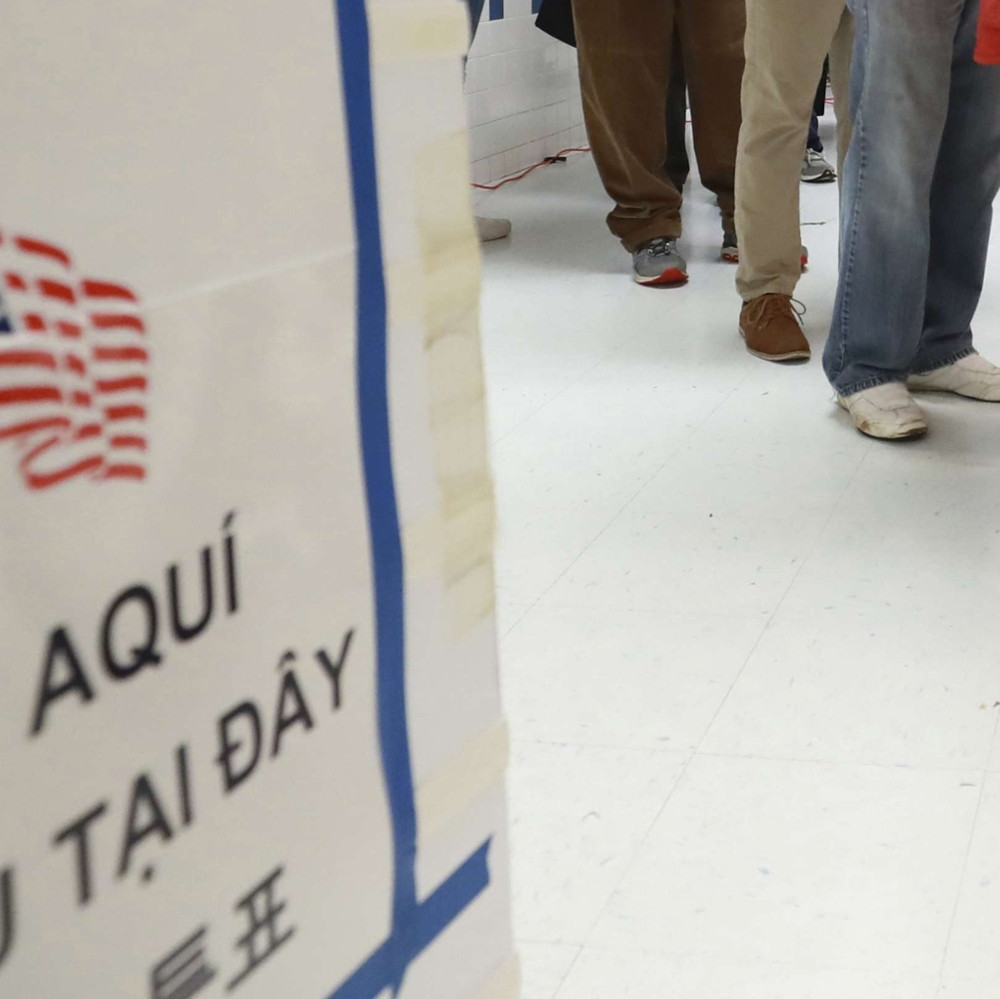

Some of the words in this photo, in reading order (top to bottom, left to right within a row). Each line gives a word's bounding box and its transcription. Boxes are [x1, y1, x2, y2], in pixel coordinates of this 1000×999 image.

[29, 510, 240, 738] AQUÍ
[51, 743, 194, 906] TẠI
[214, 627, 356, 796] ĐÂY
